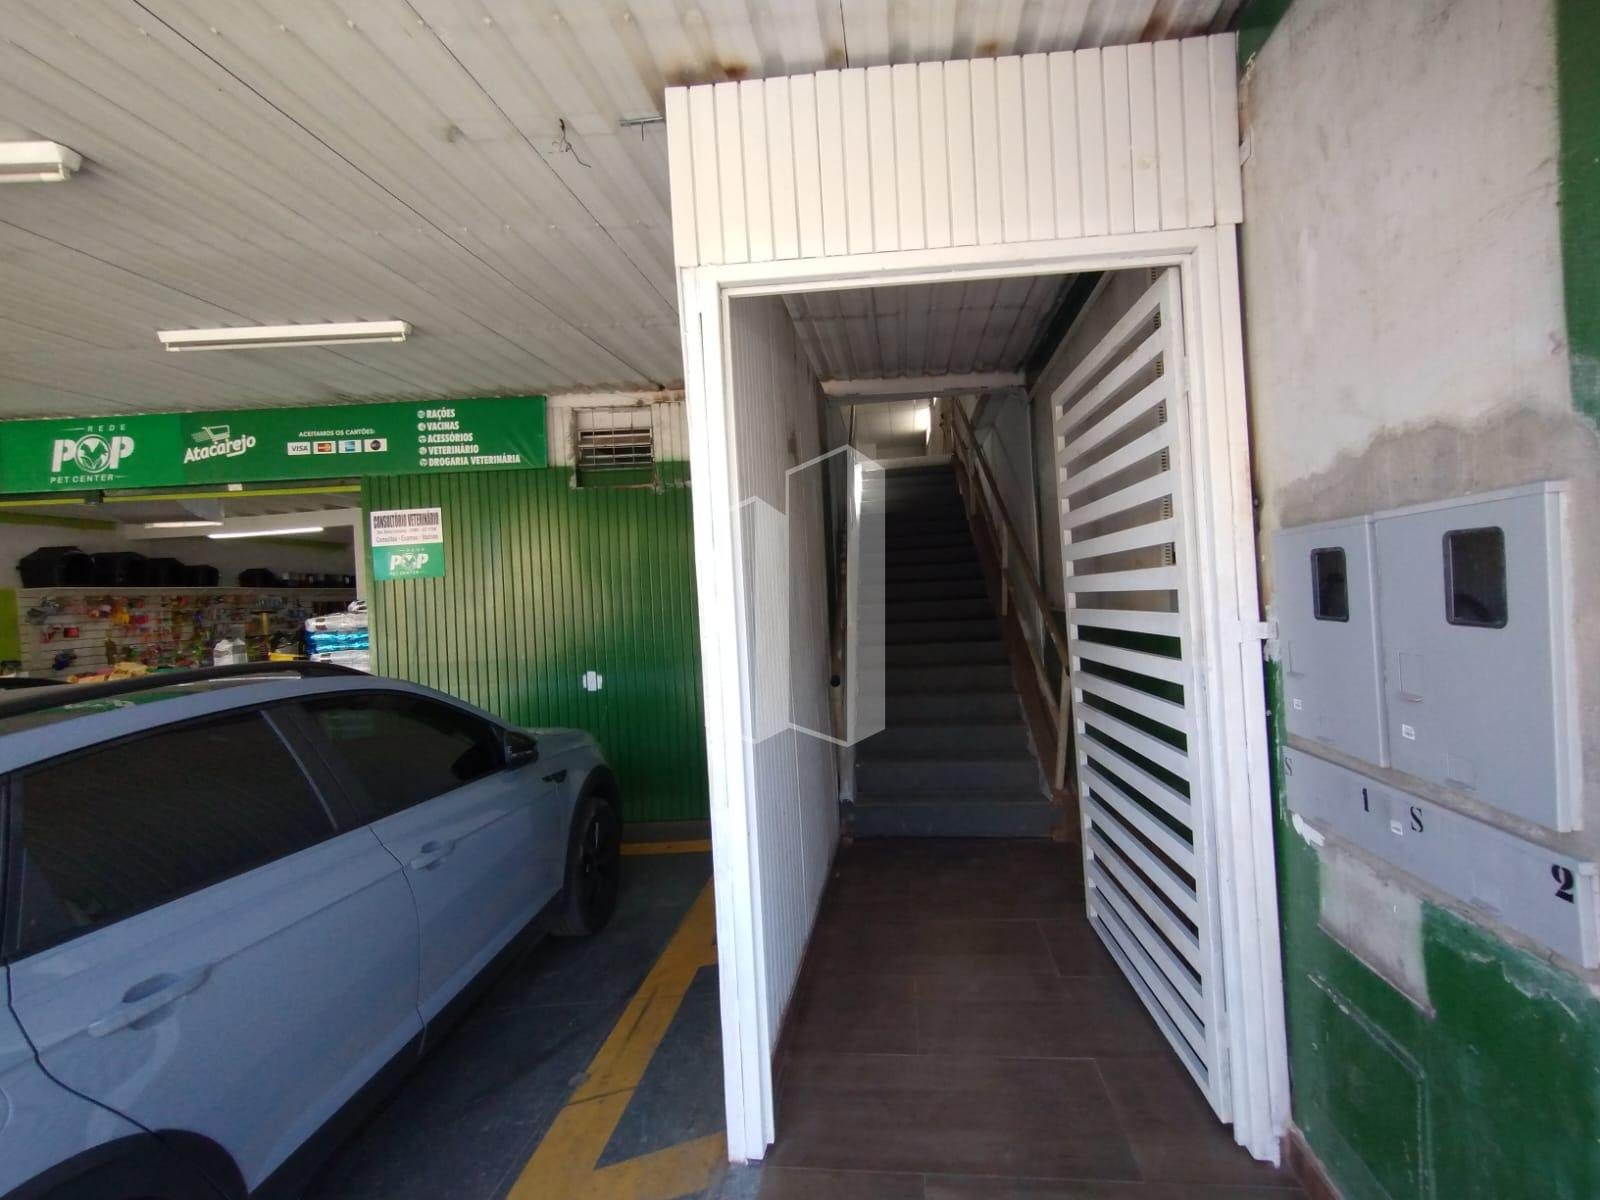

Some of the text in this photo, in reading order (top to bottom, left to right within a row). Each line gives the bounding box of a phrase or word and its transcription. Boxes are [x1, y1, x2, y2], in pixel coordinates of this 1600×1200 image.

[426, 407, 456, 420] RAÇÕES
[87, 424, 126, 432] REDE
[426, 421, 460, 431] VACINAS
[298, 430, 334, 438] ACEITAMOS
[427, 432, 473, 443] ACESSÓRIOS
[51, 433, 135, 474] POP
[183, 434, 257, 464] Atacarejo
[428, 443, 479, 455] VETERINÁRIO
[428, 452, 521, 467] DROGARIA VETERINÁRIA
[50, 474, 114, 484] PET CENTER
[373, 511, 439, 529] CONSULTÓRIO VETERINÁRIO
[1361, 788, 1370, 813] 1
[1410, 806, 1424, 832] S
[1550, 863, 1575, 904] 2
